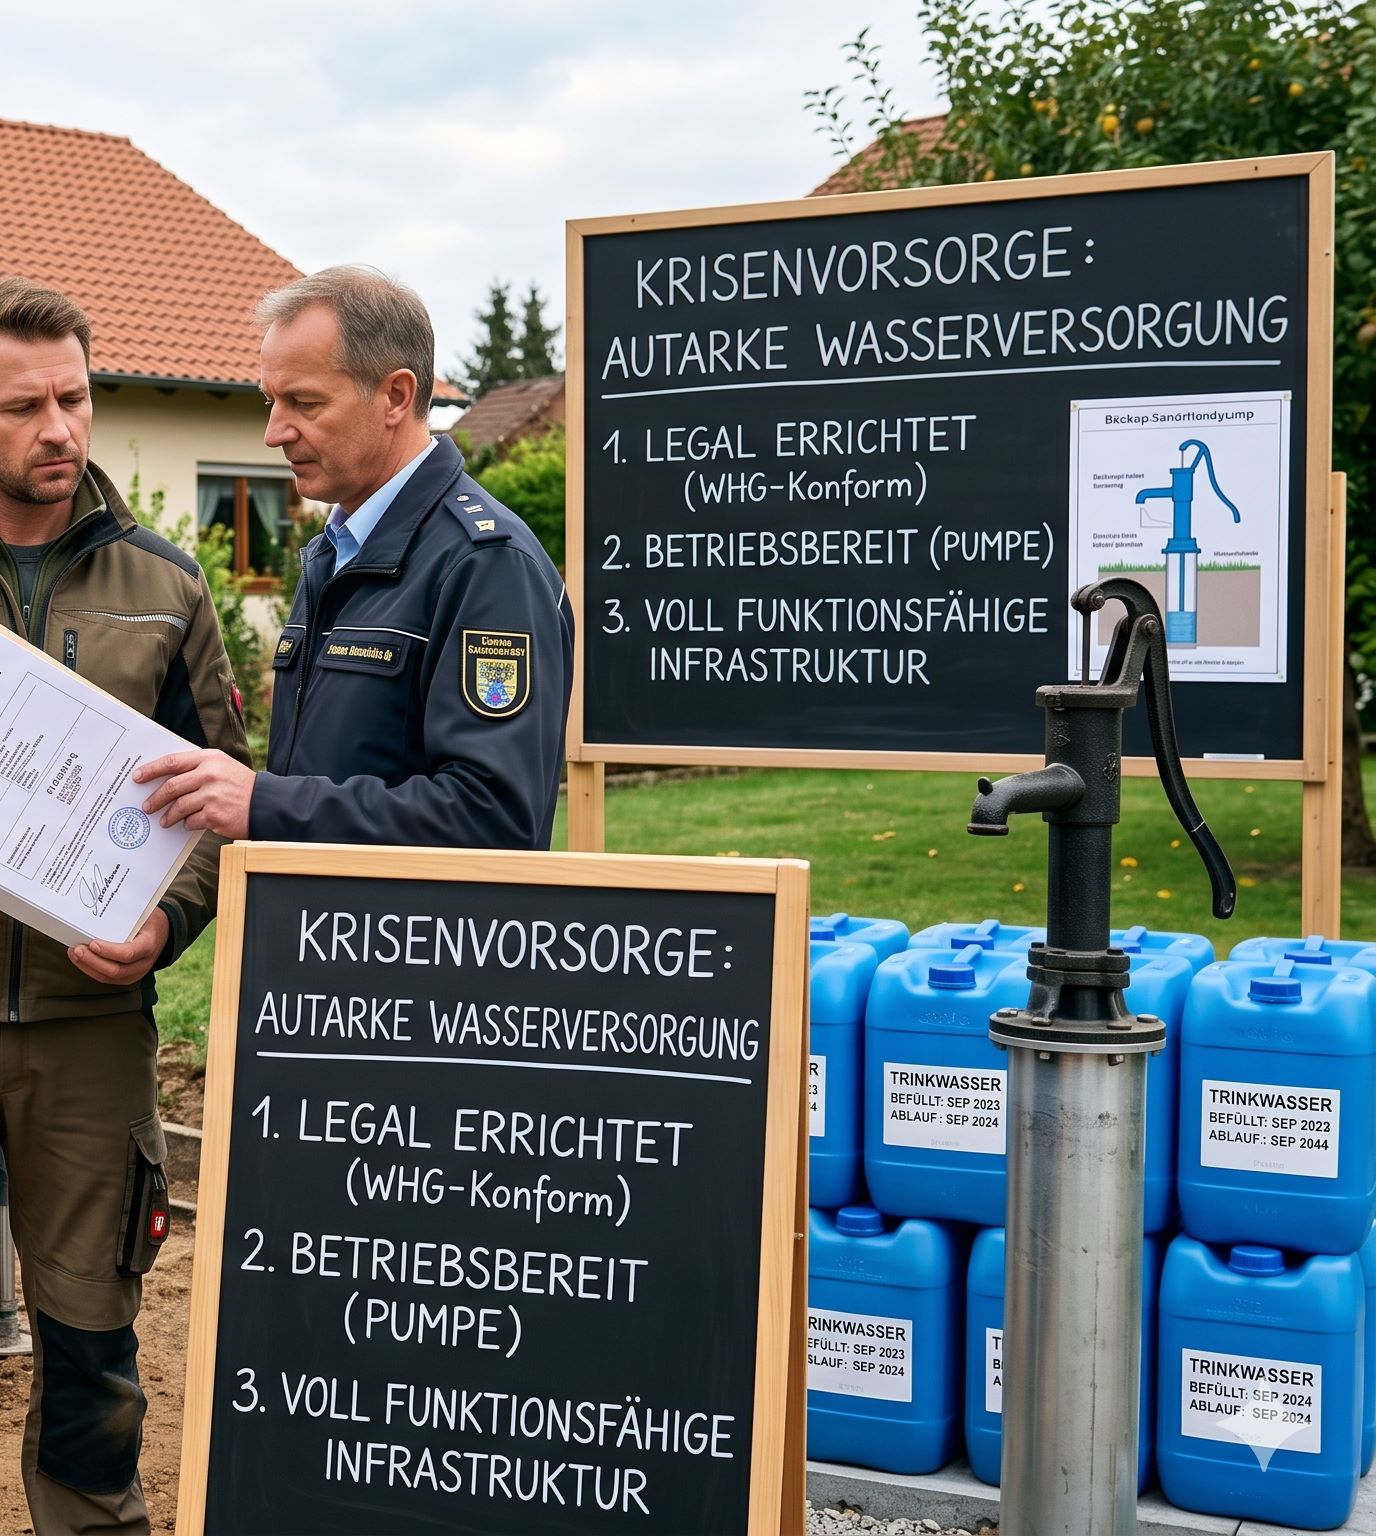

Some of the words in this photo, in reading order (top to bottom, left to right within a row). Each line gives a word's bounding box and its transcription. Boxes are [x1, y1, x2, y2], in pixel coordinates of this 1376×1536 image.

[637, 226, 1096, 309] KRISENVORSORGE:
[601, 325, 789, 380] AUTARKE
[815, 295, 1288, 368] WASSERVERSORGUNG
[602, 430, 627, 464] 1.
[645, 422, 757, 463] LEGAL
[775, 415, 977, 457] ERRICHTET
[684, 462, 926, 513] (WHG-Konform)
[602, 534, 631, 570] 2.
[645, 529, 919, 569] BETRIEBSBEREIT
[930, 521, 1054, 572] (PUMPE)
[602, 598, 631, 634] 3.
[644, 598, 724, 633] VOLL
[738, 590, 1049, 634] FUNKTIONSFÄHIGE
[650, 647, 930, 685] INFRASTRUKTUR
[298, 909, 733, 977] KRISENVORSORGE:
[254, 991, 414, 1042] AUTARKE
[429, 1000, 760, 1061] WASSERVERSORGUNG
[890, 1071, 1002, 1092] TRINKWASSER
[890, 1092, 944, 1108] BEFÜLLT:
[947, 1096, 971, 1110] SEP
[973, 1098, 1001, 1111] 2023
[1209, 1089, 1333, 1113] TRINKWASSER
[251, 1095, 280, 1140] 1.
[299, 1098, 432, 1149] LEGAL
[454, 1108, 694, 1167] ERRICHTET
[945, 1113, 969, 1126] SEP
[972, 1116, 999, 1128] 2024
[1209, 1111, 1267, 1128] BEFÜLLT:
[1271, 1117, 1297, 1130] SEP
[1270, 1135, 1296, 1148] SEP
[1299, 1137, 1329, 1151] 2044
[346, 1156, 631, 1227] (WHG-Konform)
[240, 1228, 276, 1274] 2.
[291, 1231, 649, 1303] BETRIEBSBEREIT
[344, 1291, 522, 1359] (PUMPE)
[808, 1316, 907, 1342] RINKWASSER
[807, 1337, 851, 1354] EFÜLLT:
[853, 1343, 876, 1356] SEP
[878, 1347, 906, 1360] 2023
[852, 1360, 876, 1373] SEP
[878, 1364, 905, 1377] 2024
[1189, 1357, 1314, 1388] TRINKWASSER
[1189, 1381, 1248, 1400] BEFÜLLT:
[1253, 1389, 1279, 1403] SEP
[1282, 1393, 1313, 1408] 2024
[232, 1367, 267, 1414] 3.
[281, 1371, 371, 1423] VOLL
[385, 1382, 735, 1459] FUNKTIONSFÄHIGE
[1189, 1399, 1245, 1417] ABLAUF:
[1252, 1407, 1279, 1421] SEP
[1281, 1411, 1312, 1425] 2024
[325, 1438, 650, 1515] INFRASTRUKTUR
